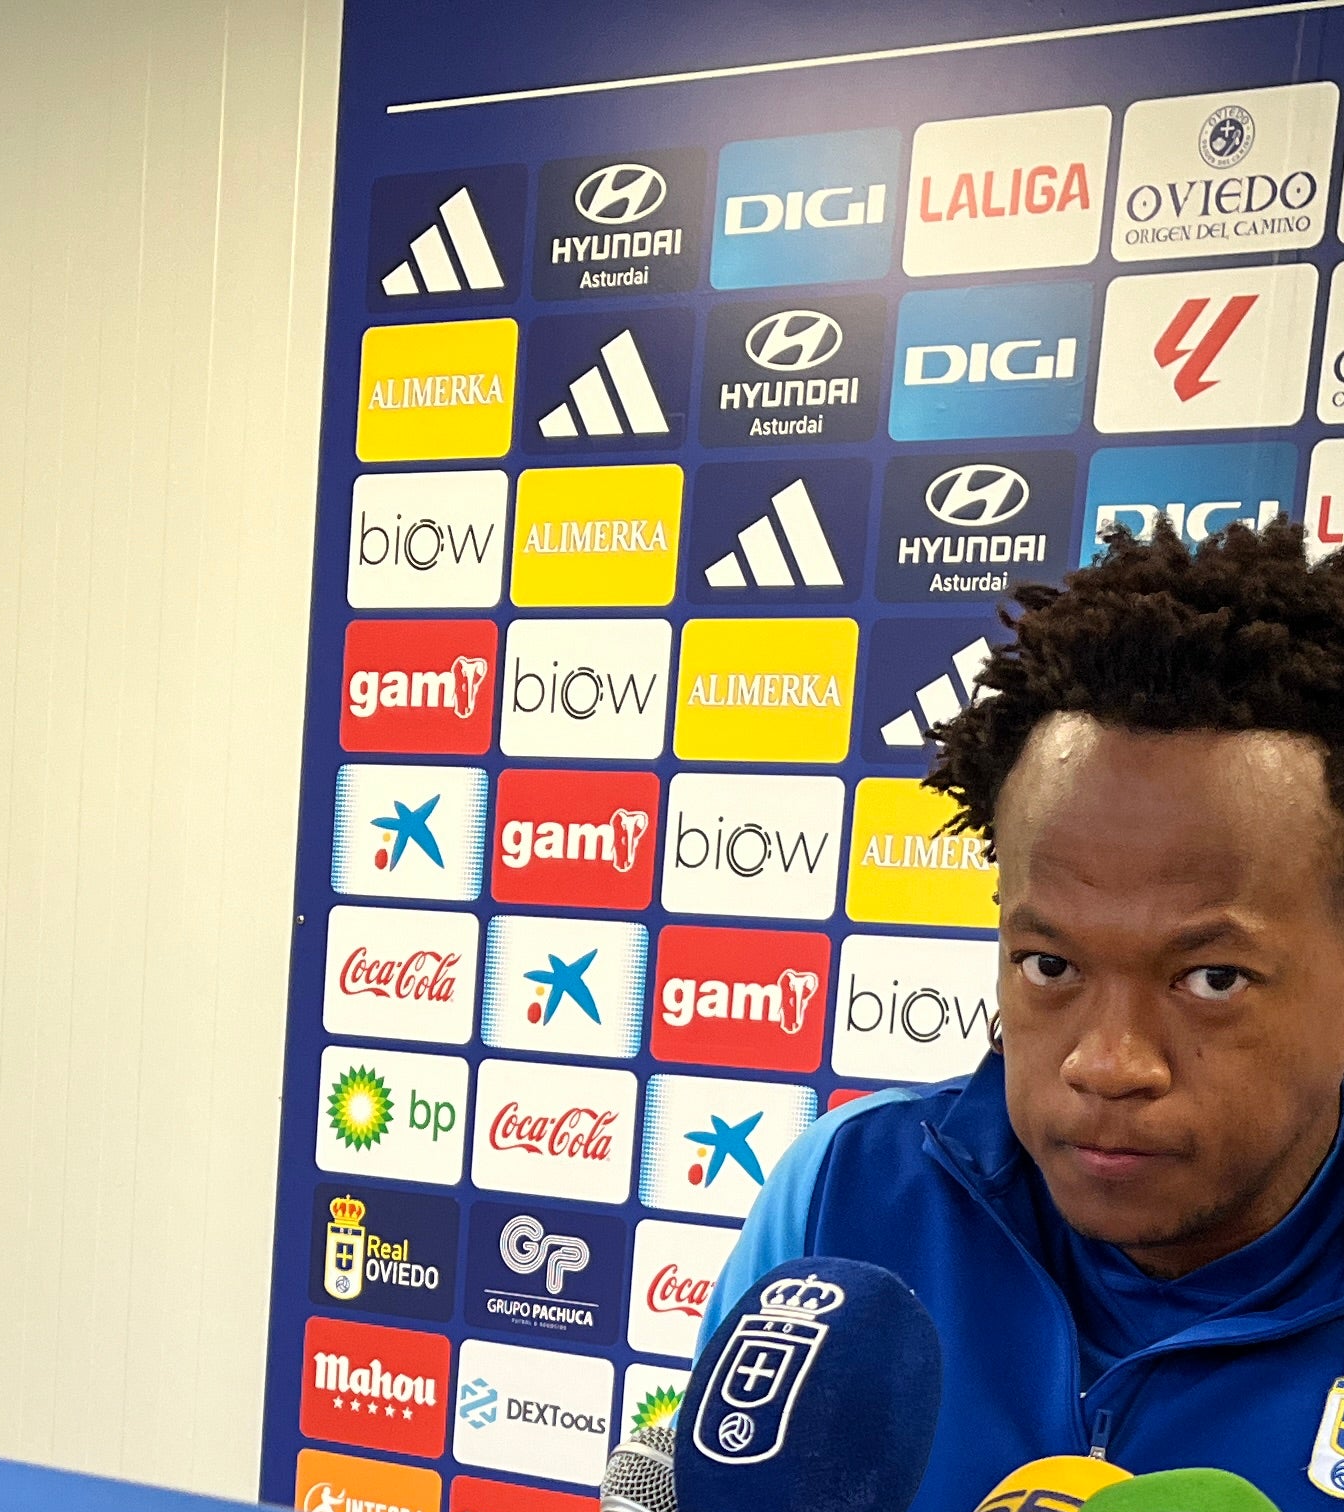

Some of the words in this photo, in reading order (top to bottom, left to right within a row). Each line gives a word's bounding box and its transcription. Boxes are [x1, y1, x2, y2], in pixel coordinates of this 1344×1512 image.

[724, 183, 886, 236] DIGI
[920, 162, 1091, 223] LALIGA
[1126, 171, 1317, 223] OVIEDO
[551, 228, 682, 264] HYUNDAI
[1125, 224, 1191, 245] ORIGEN
[1196, 222, 1230, 240] DEL
[1233, 215, 1311, 237] CAMINO
[579, 266, 649, 290] Asturdai
[904, 338, 1078, 387] DIGI
[368, 372, 505, 411] ALIMERKA
[719, 376, 859, 410] HYUNDAI
[749, 413, 823, 438] Asturdai
[359, 510, 495, 571] biow
[522, 519, 669, 556] ALIMERKA
[898, 533, 1047, 566] HYUNDAI
[929, 570, 1008, 593] Asturdai
[514, 660, 656, 720] biow
[687, 673, 842, 708] ALIMERKA
[675, 811, 828, 878] biow
[861, 834, 999, 870] ALIMER
[340, 947, 462, 1003] Coca-Cola
[409, 1089, 456, 1141] bp
[489, 1101, 619, 1162] Coca-Cola
[367, 1234, 408, 1260] Real
[365, 1260, 439, 1290] OVIEDO
[487, 1299, 530, 1317] GRUPO
[532, 1304, 593, 1327] PACHUCA
[313, 1351, 437, 1407] Mahou
